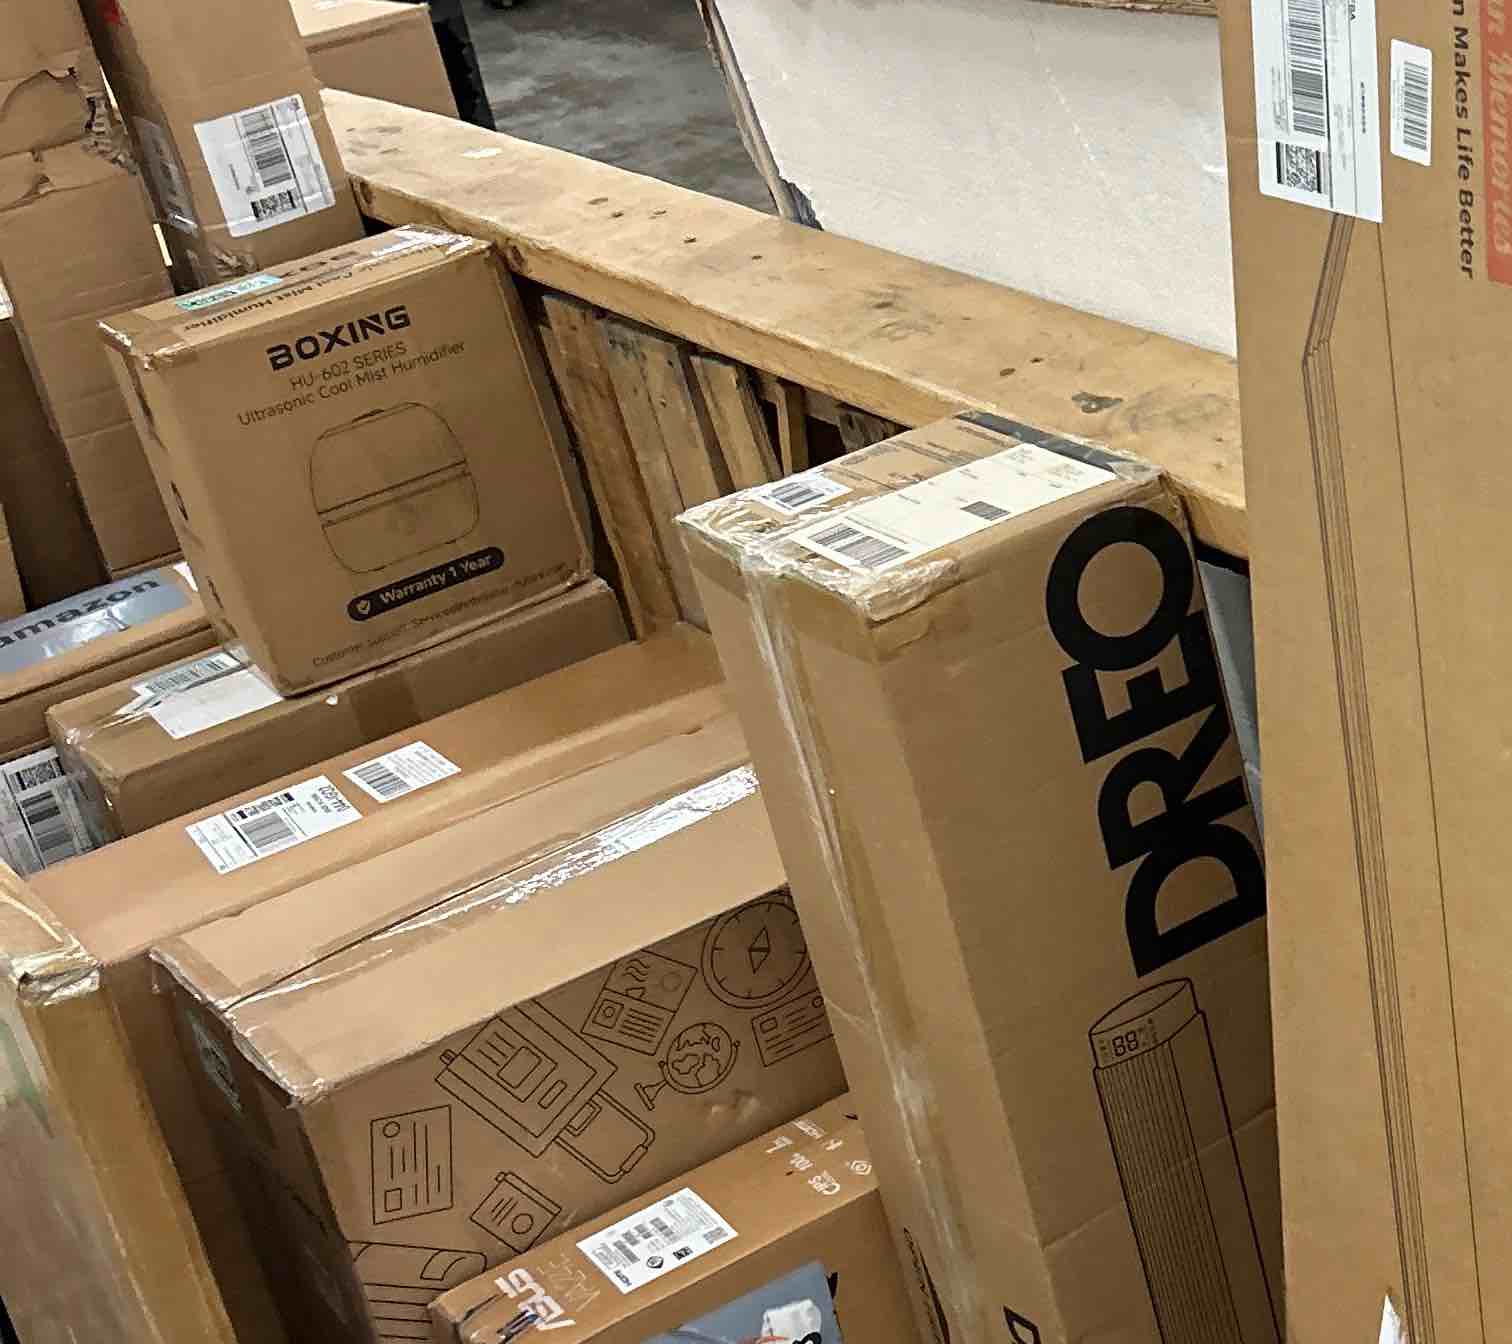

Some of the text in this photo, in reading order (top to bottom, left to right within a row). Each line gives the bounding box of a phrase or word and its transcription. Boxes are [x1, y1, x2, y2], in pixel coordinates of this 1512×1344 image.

[1453, 26, 1471, 120] Makes
[1457, 127, 1474, 180] Life
[1459, 188, 1475, 279] Better
[266, 304, 411, 372] BOXING
[236, 341, 466, 427] Ultrasonic Cool Mist Humidifier
[380, 555, 492, 605] Warranty 1 Year
[1046, 505, 1268, 979] DREO
